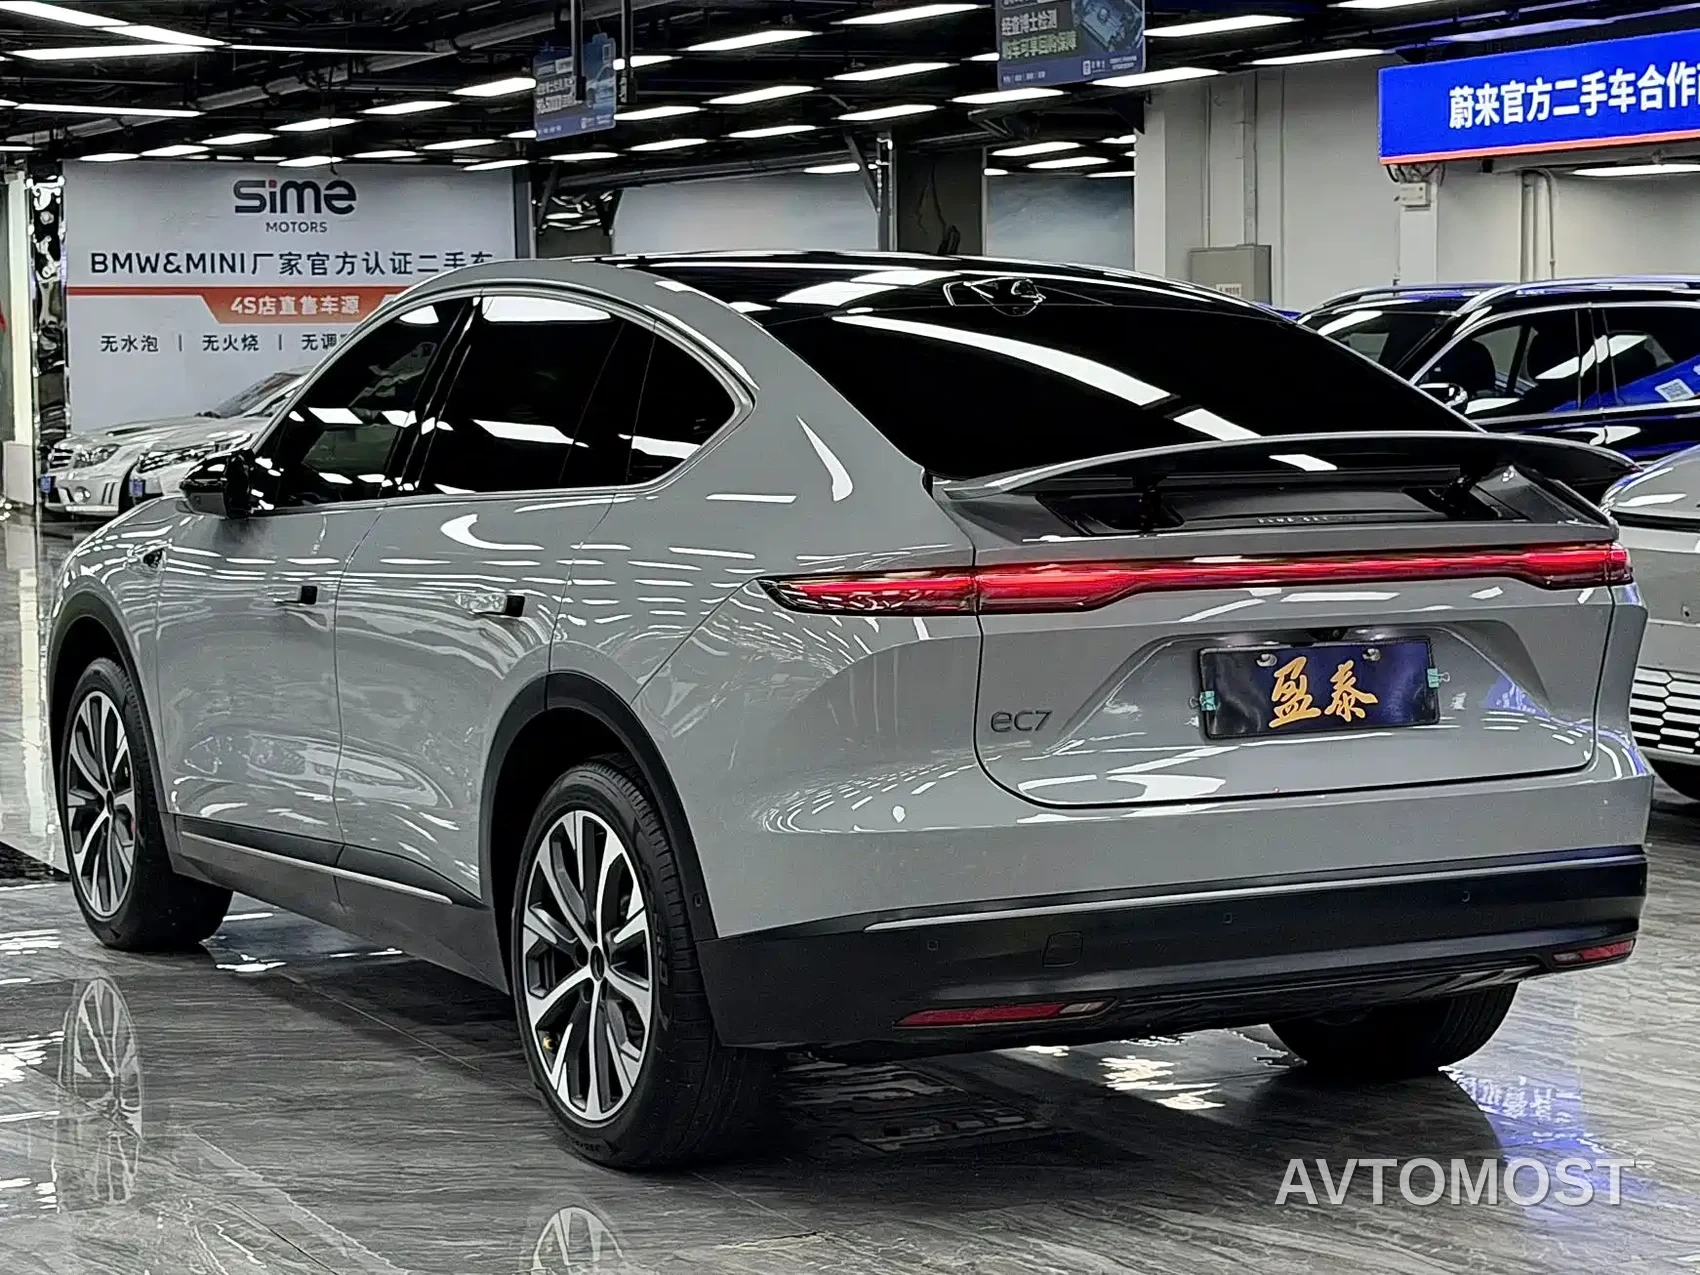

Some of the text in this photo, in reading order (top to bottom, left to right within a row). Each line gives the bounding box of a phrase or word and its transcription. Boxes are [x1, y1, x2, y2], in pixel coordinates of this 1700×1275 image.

[1448, 61, 1700, 129] 蔚来官方二手车合作
[265, 221, 328, 233] MOTORS
[100, 333, 348, 352] 无水泡 无火烧 无调
[1268, 656, 1379, 729] 盈泰
